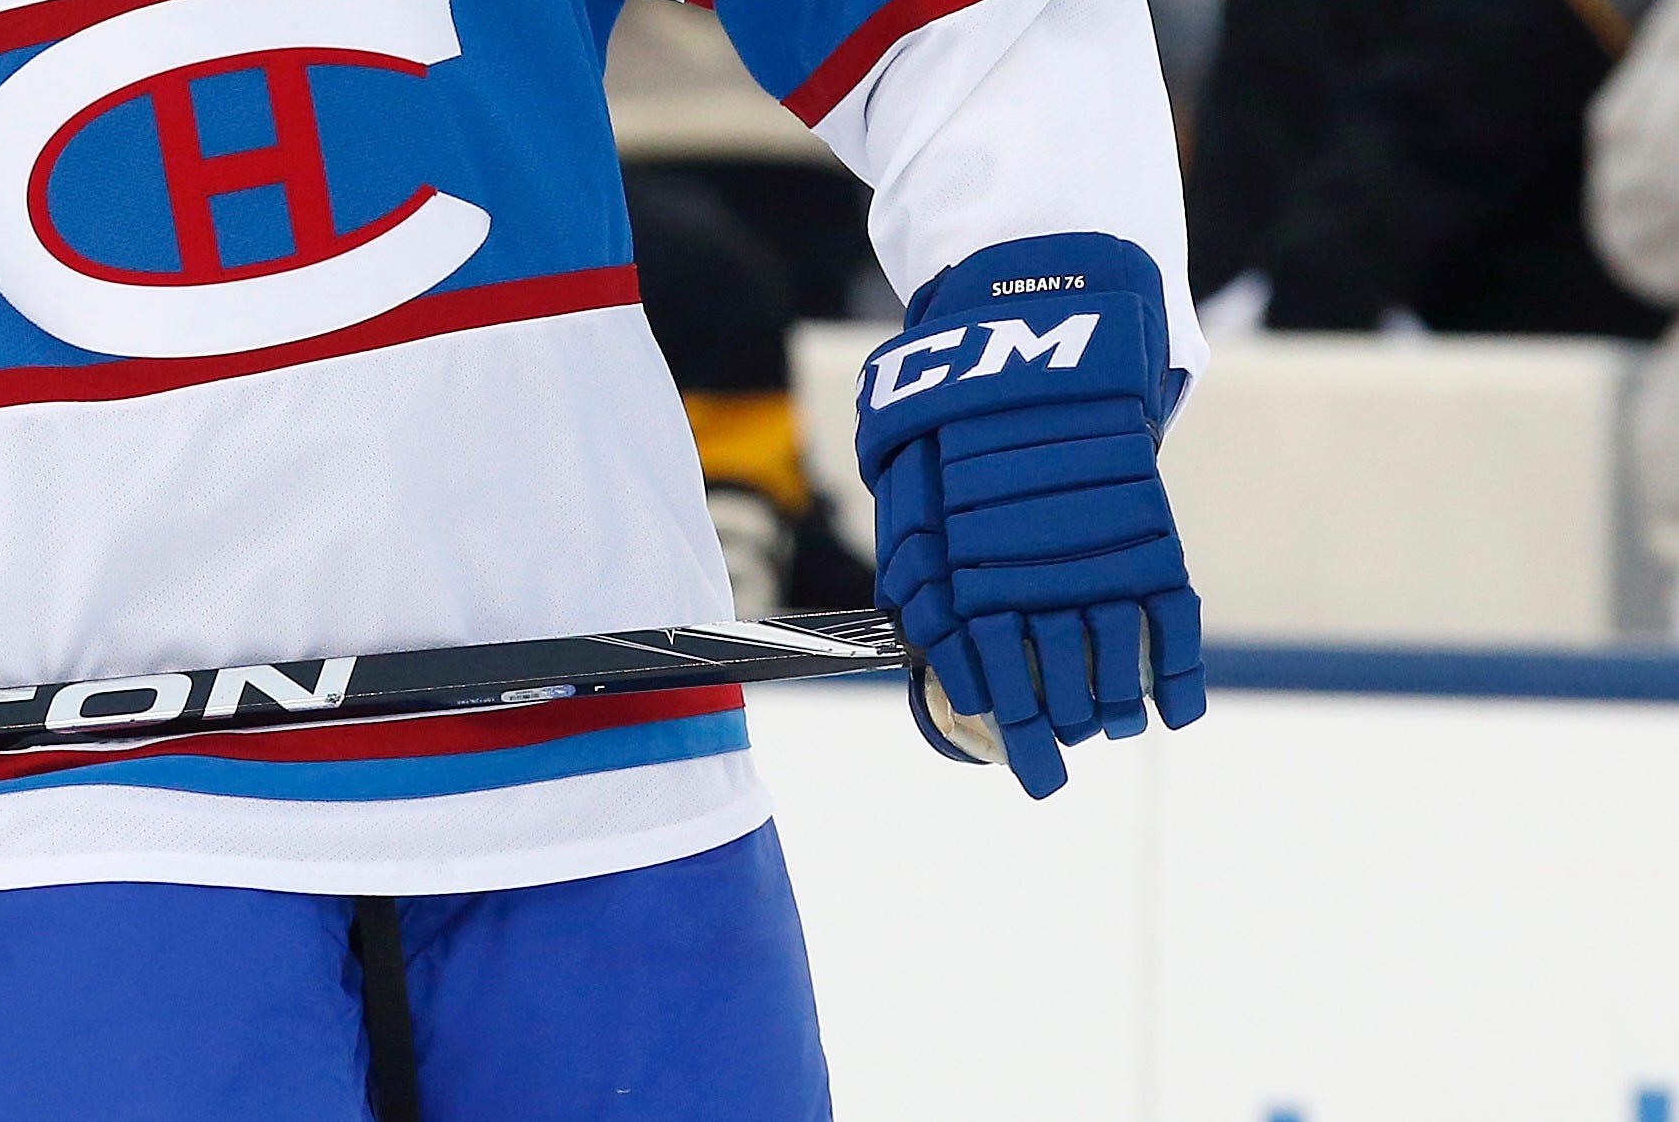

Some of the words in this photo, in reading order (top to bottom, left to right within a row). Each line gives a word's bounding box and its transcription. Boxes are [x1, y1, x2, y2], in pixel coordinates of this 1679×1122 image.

[991, 277, 1061, 297] SUBBAN
[1064, 275, 1085, 290] 76
[856, 312, 1101, 418] CM
